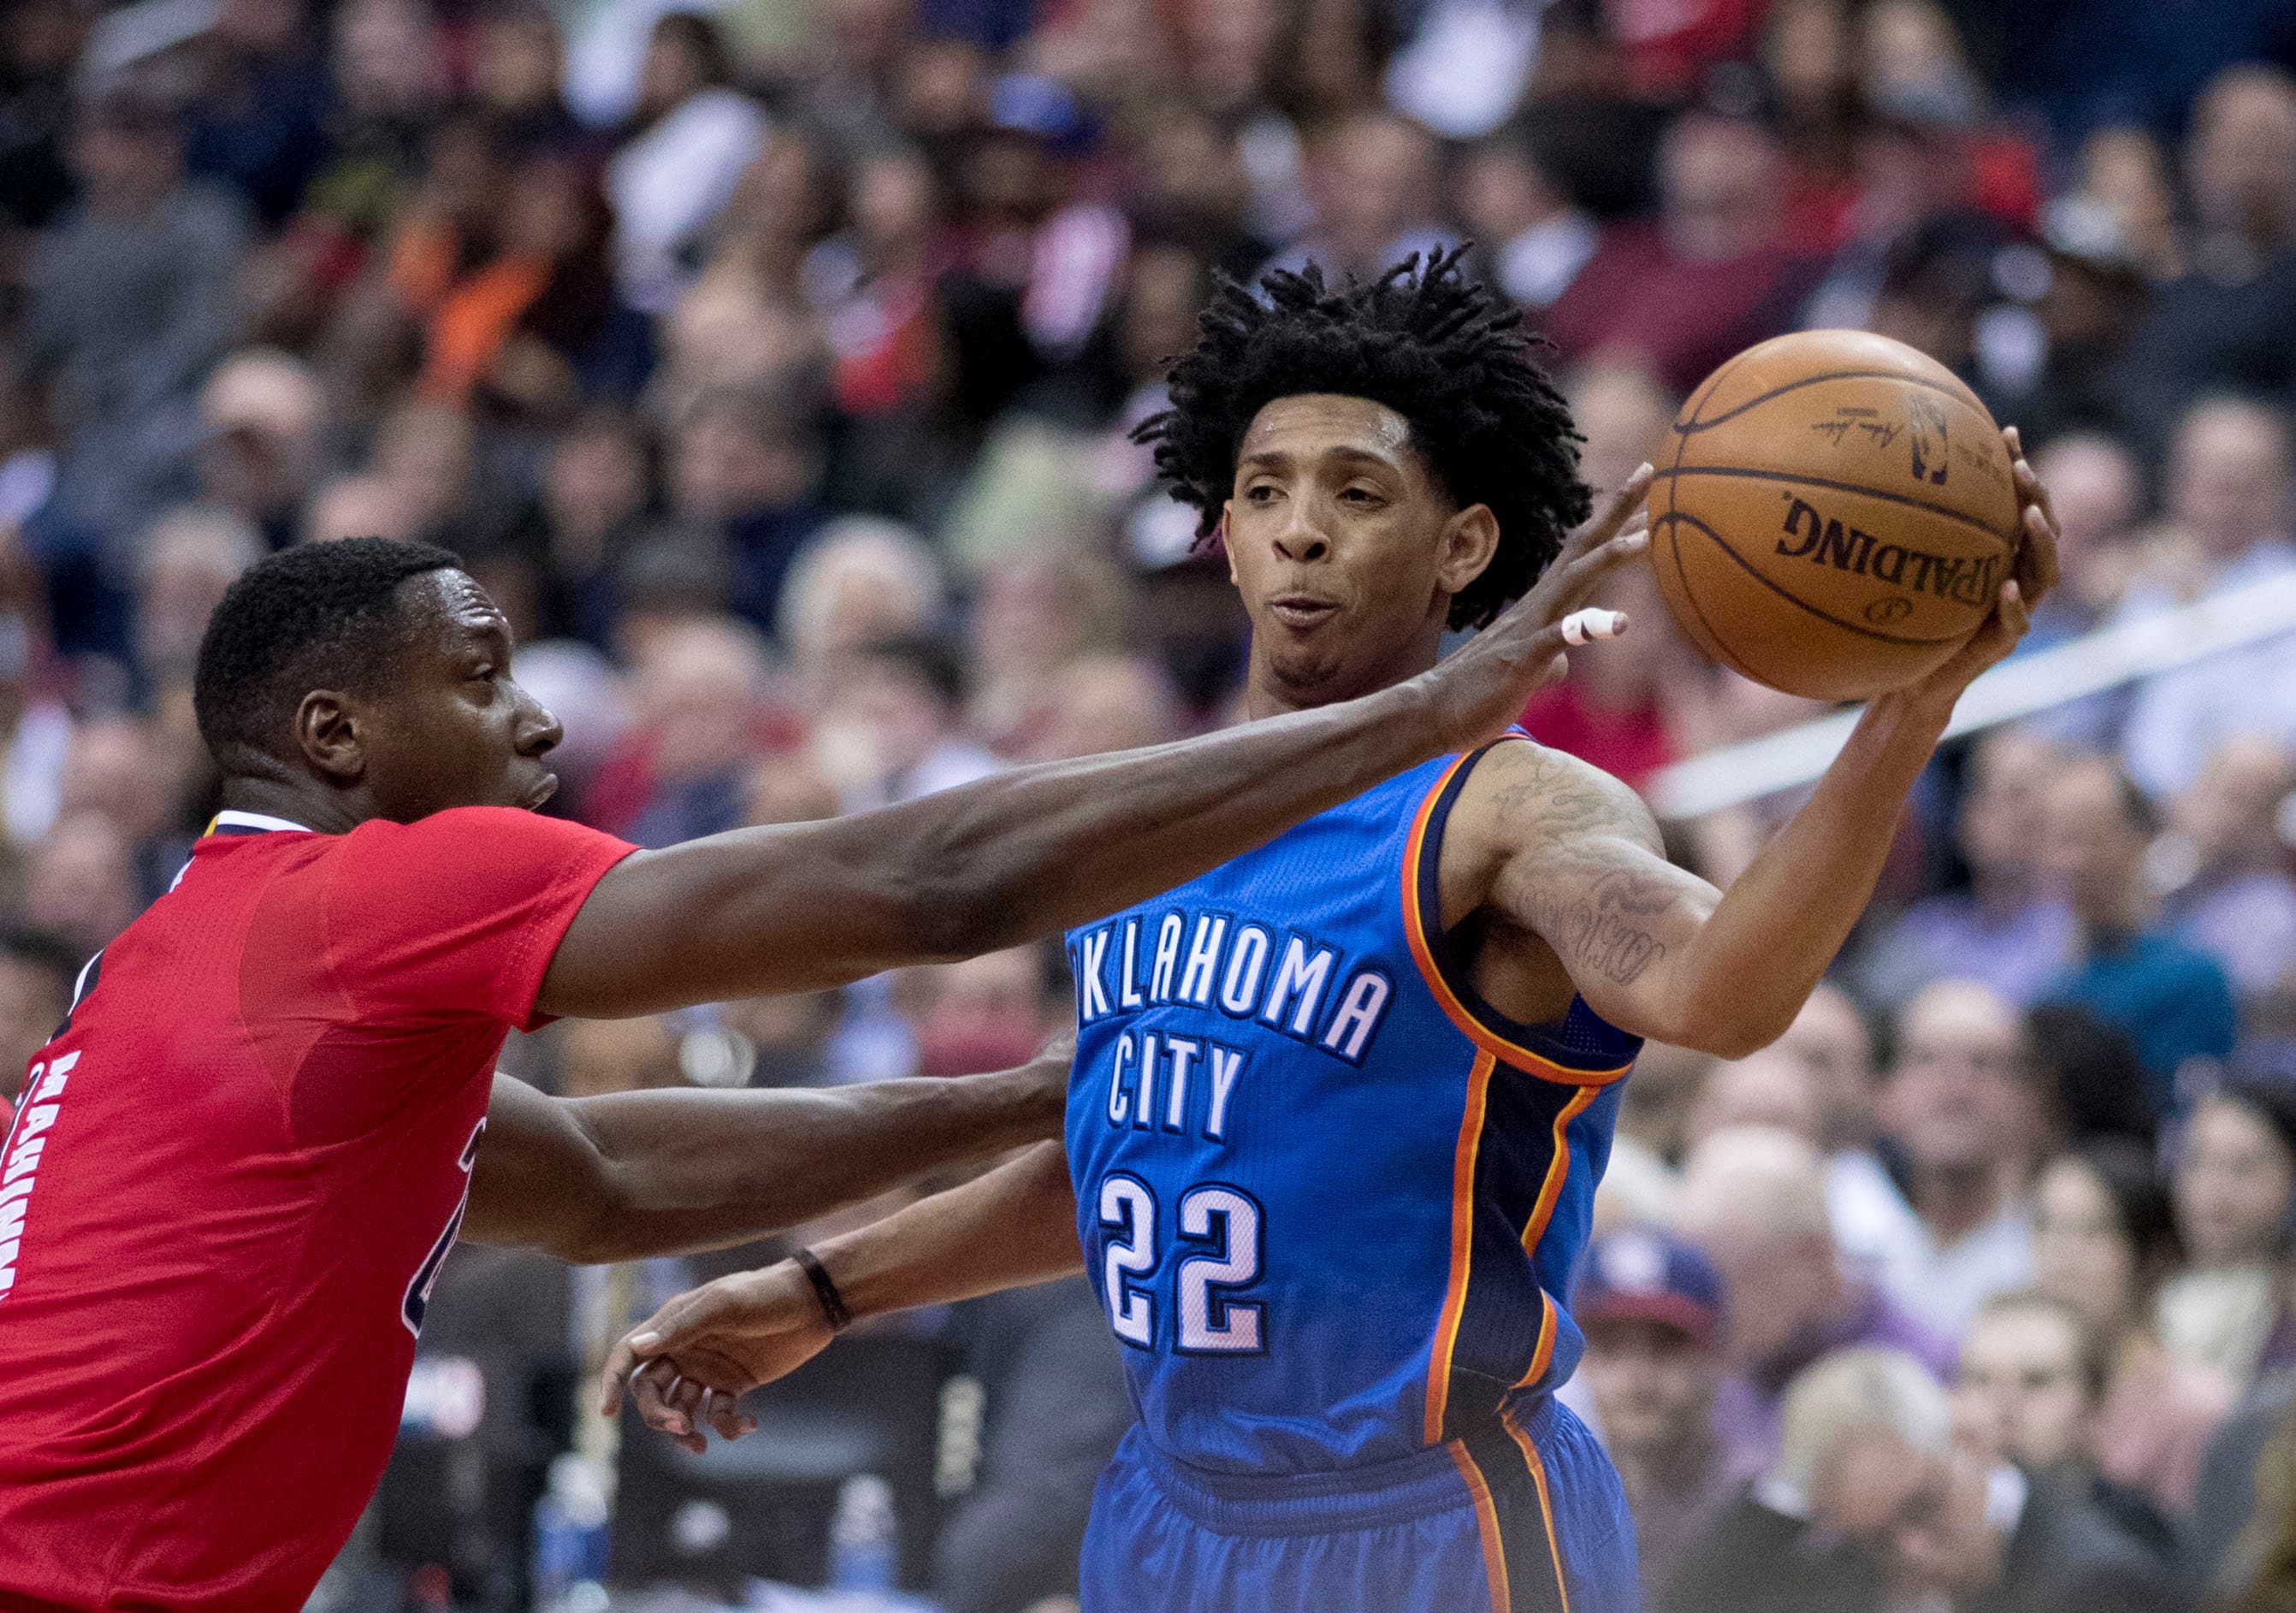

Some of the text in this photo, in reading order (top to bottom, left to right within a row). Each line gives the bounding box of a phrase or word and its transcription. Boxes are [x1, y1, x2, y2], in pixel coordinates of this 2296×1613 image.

[1774, 496, 2002, 607] SPALDING
[1069, 907, 1396, 1069] KLAHOMA
[1107, 1028, 1249, 1143] CITY
[1098, 1171, 1268, 1355] 22
